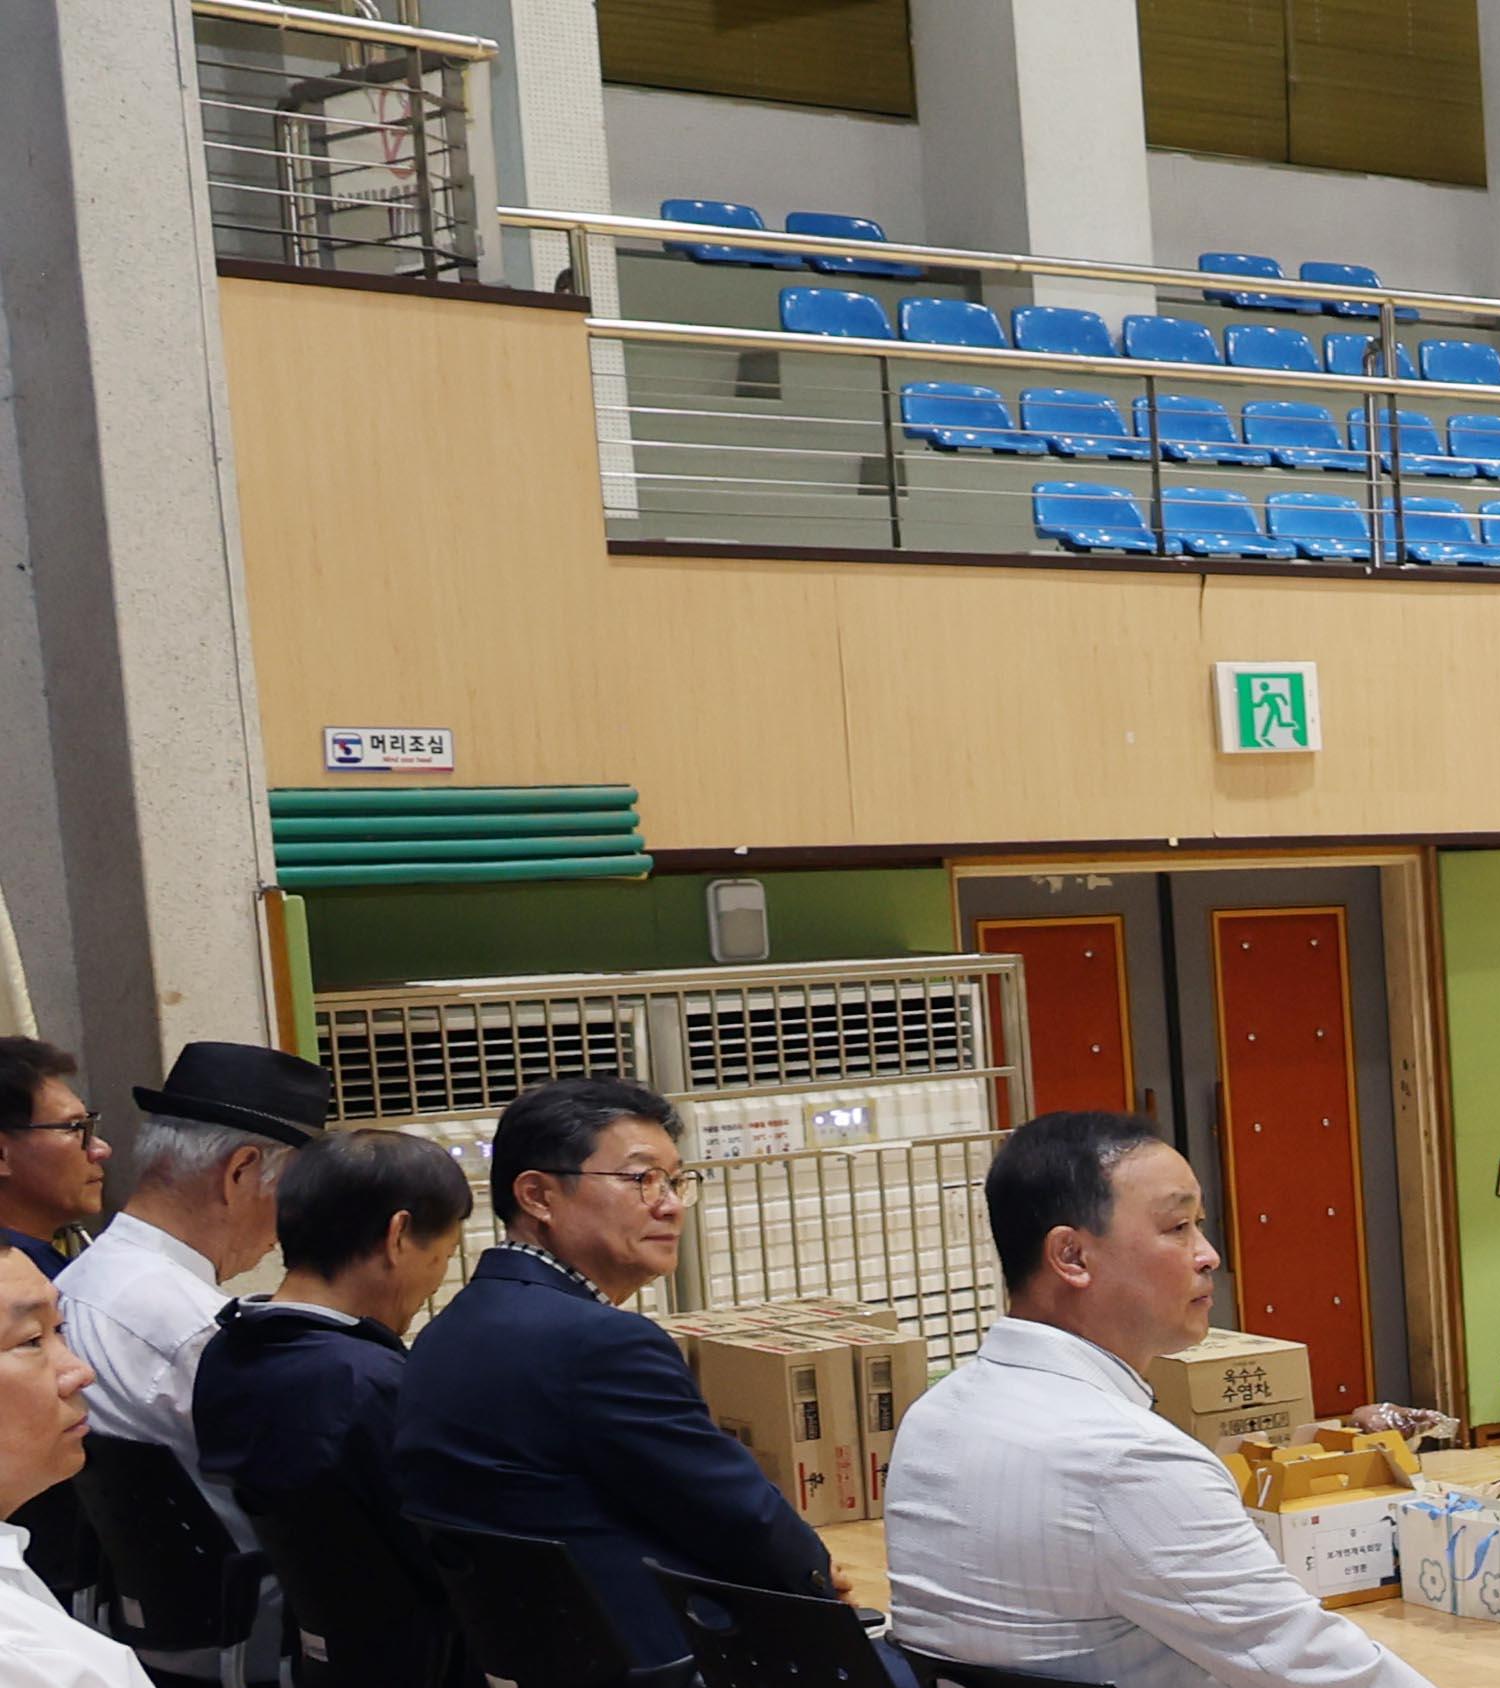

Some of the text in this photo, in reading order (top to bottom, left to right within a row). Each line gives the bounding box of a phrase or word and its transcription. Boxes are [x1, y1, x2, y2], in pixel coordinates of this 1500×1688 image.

[370, 734, 444, 755] 머리조심
[1223, 1366, 1267, 1385] 옥수수
[1222, 1382, 1272, 1403] 수염차
